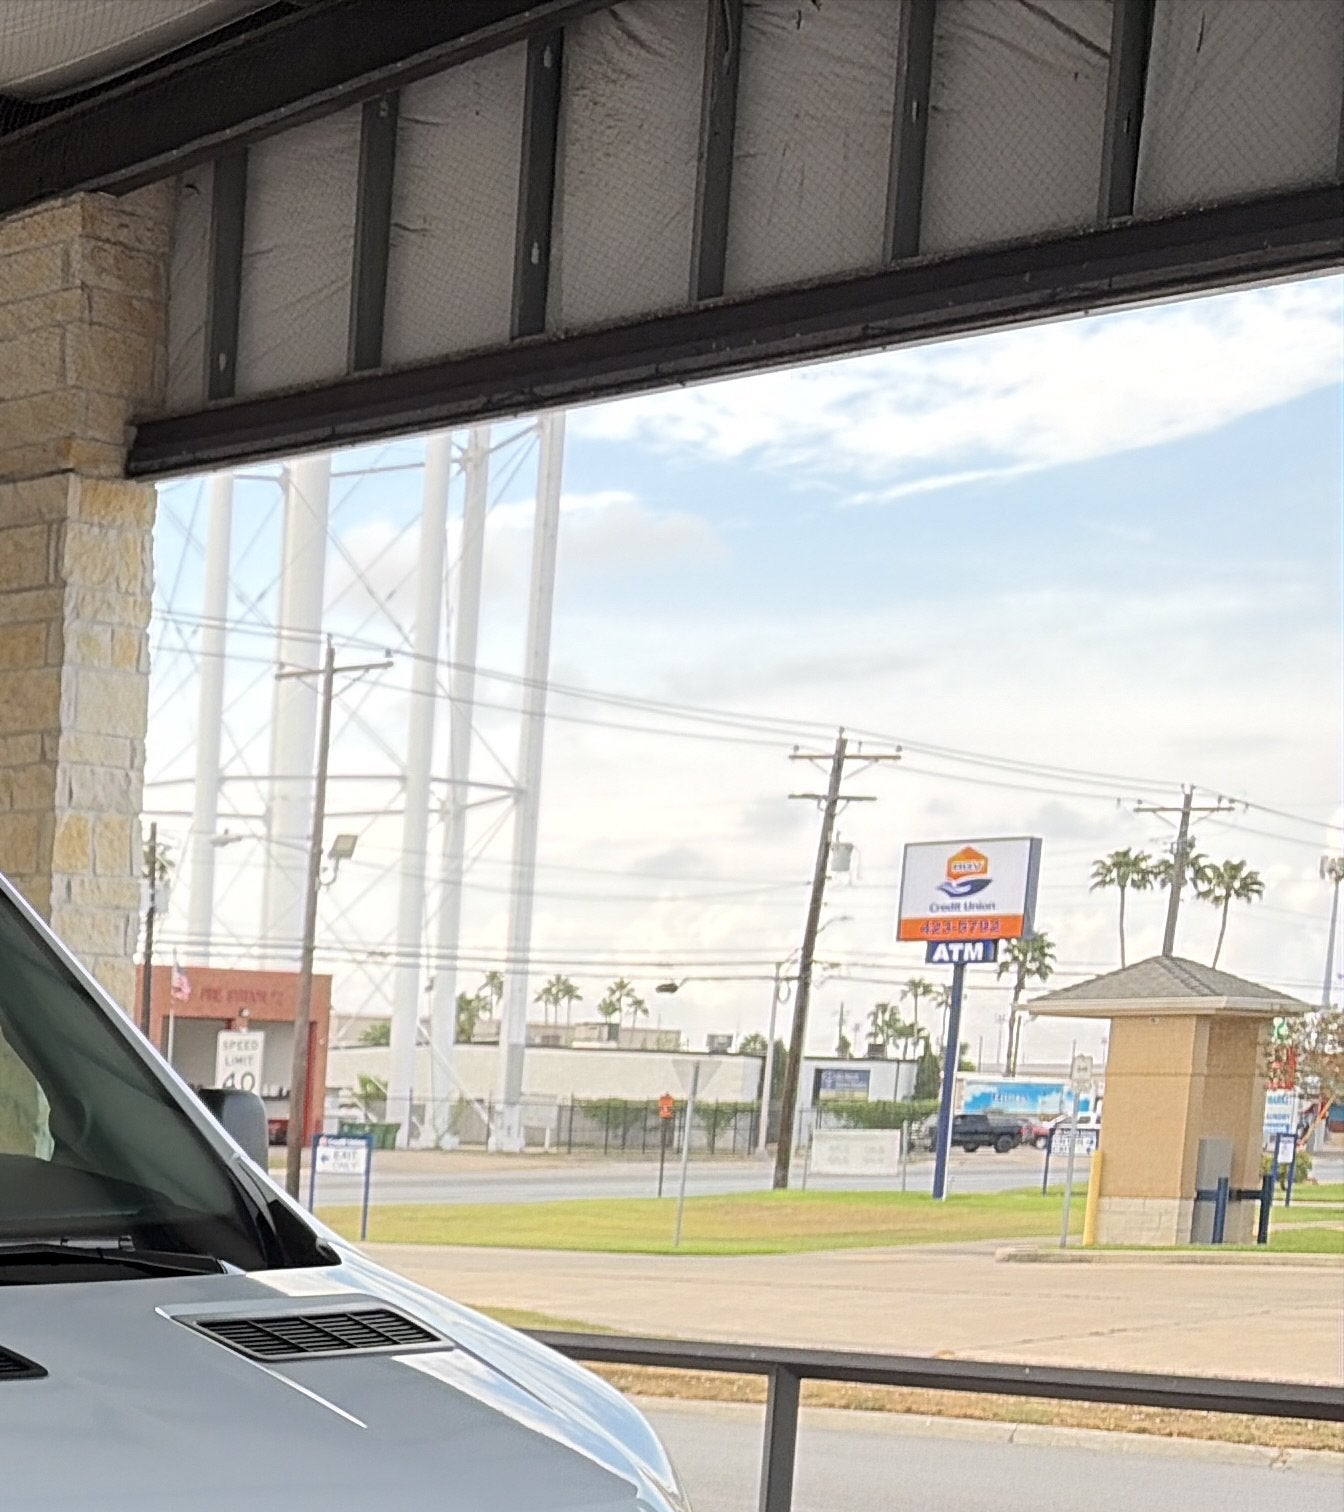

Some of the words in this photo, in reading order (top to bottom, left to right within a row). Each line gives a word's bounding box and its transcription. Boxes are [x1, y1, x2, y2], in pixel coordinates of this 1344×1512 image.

[929, 902, 961, 914] Credit
[963, 900, 996, 912] Union
[932, 942, 984, 962] ATM
[223, 1038, 259, 1050] SPEED
[224, 1055, 254, 1067] LIMIT
[222, 1072, 256, 1091] 40
[333, 1150, 358, 1161] EXIT
